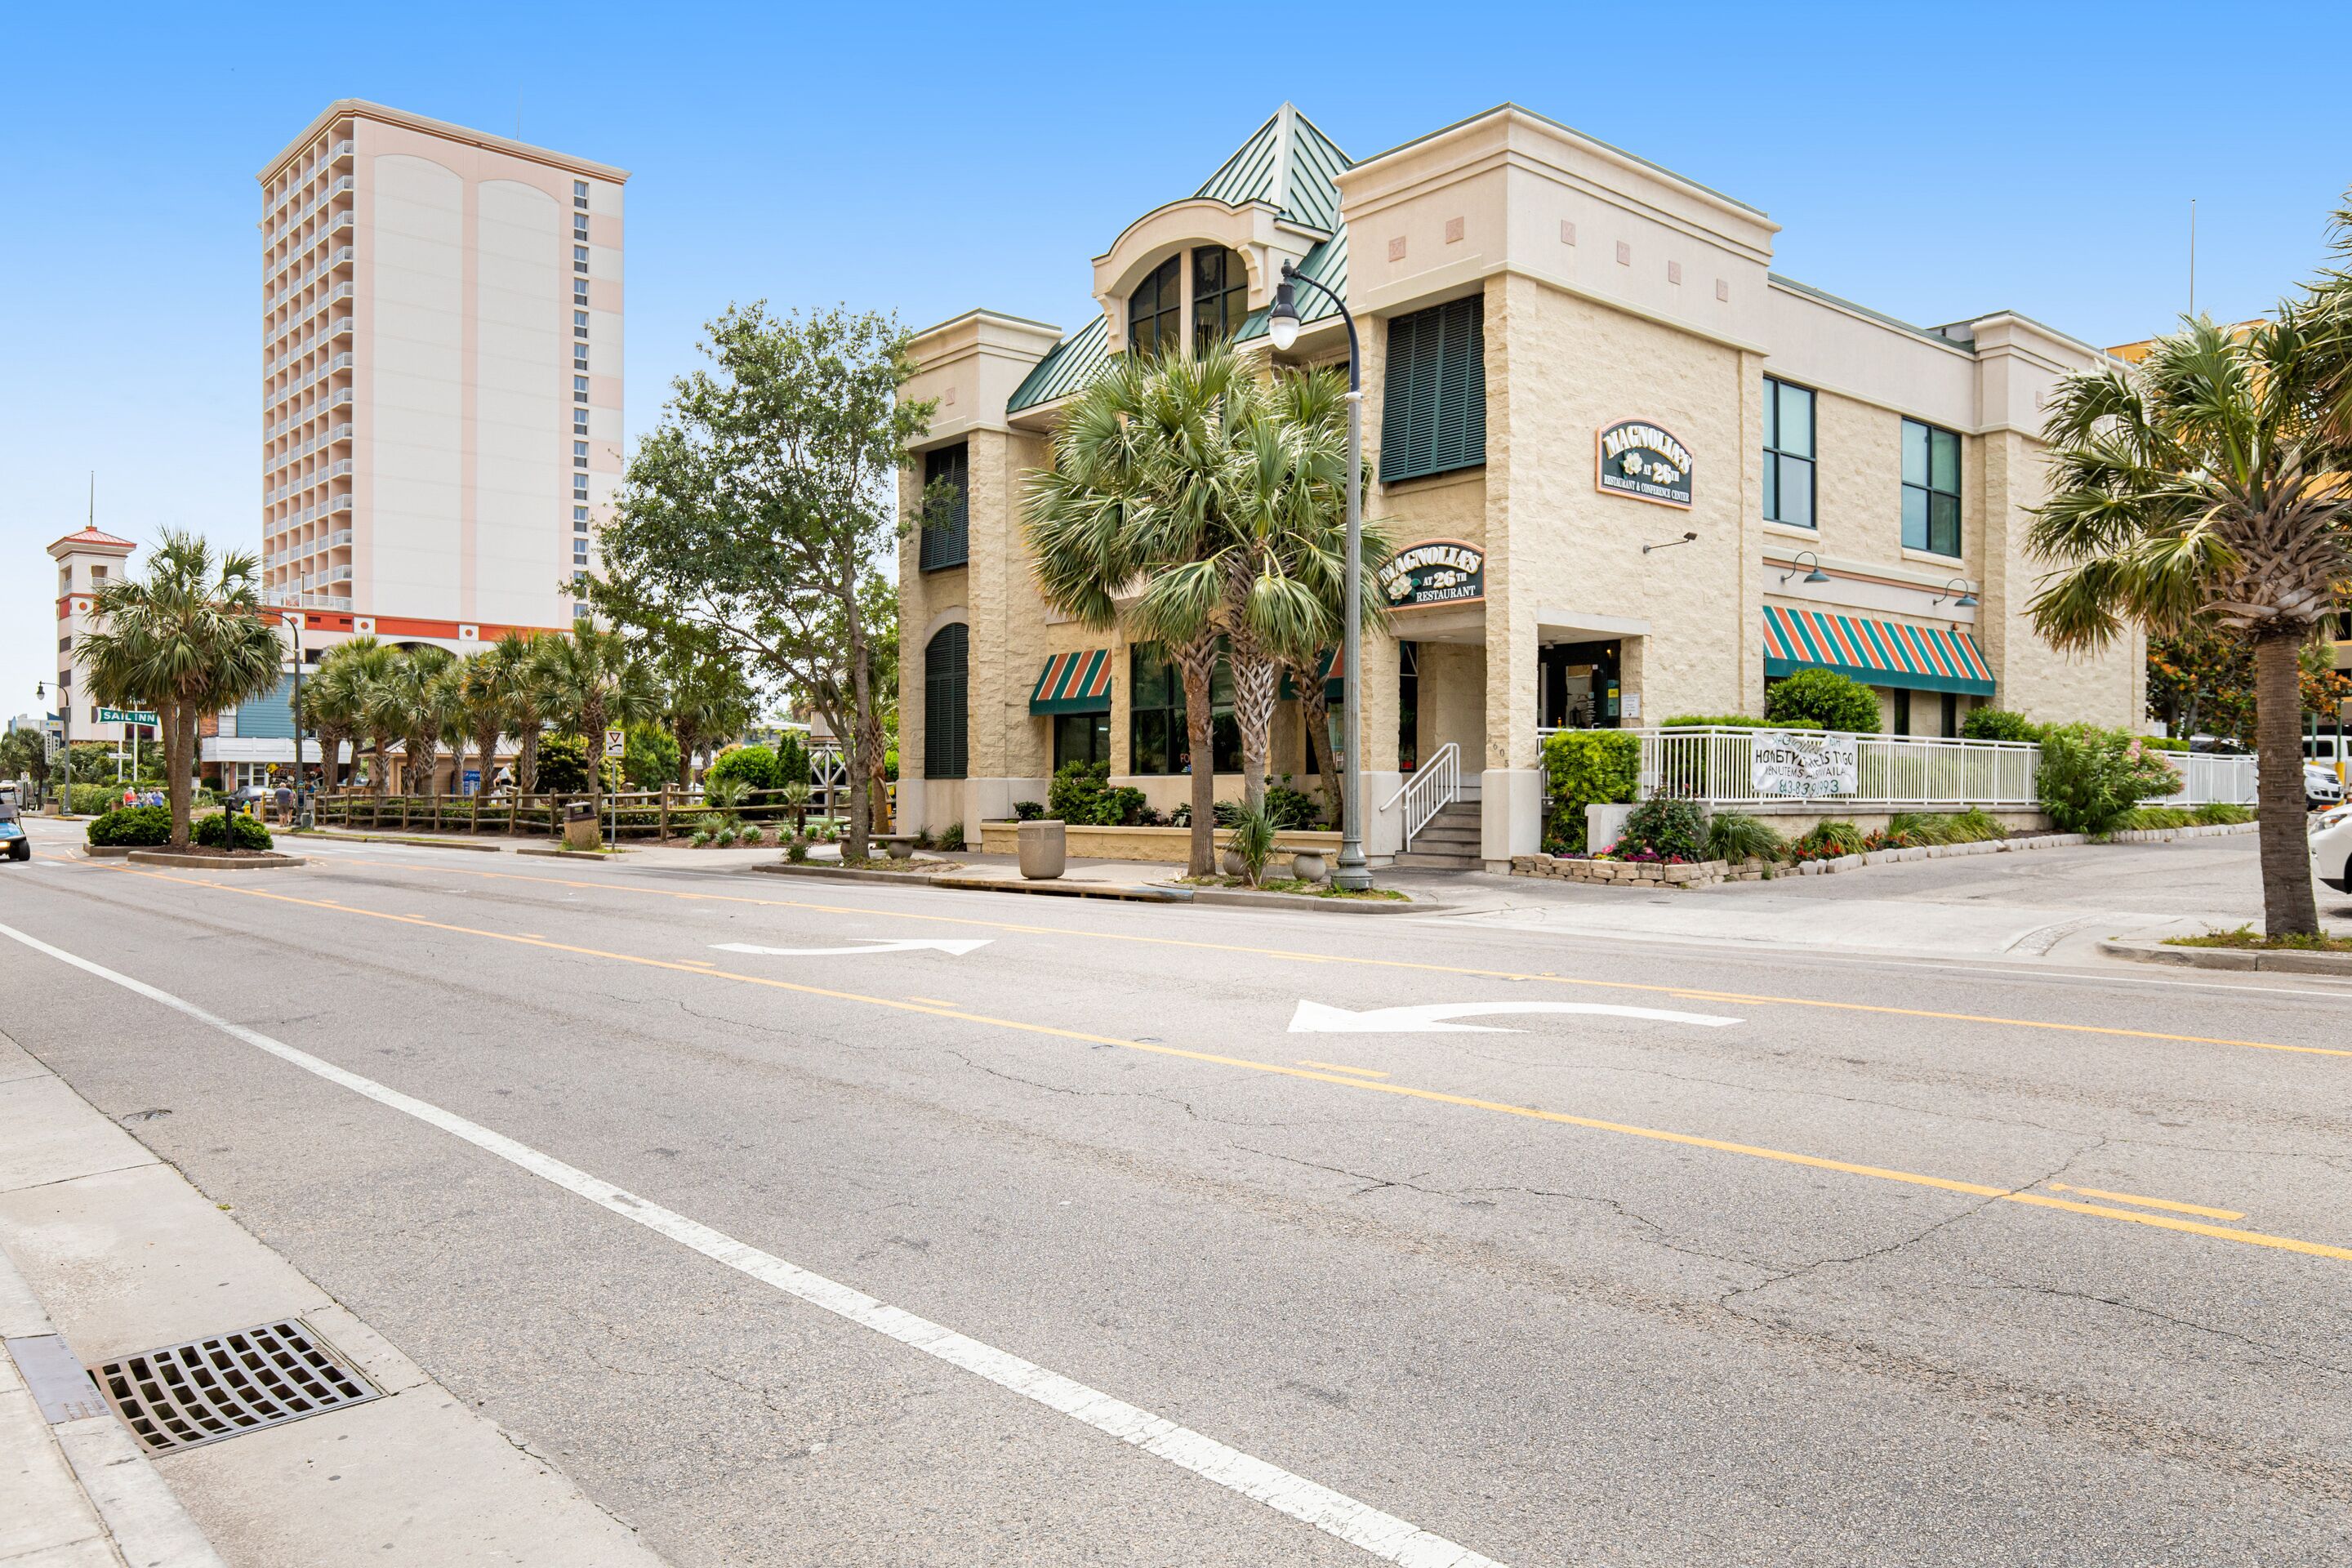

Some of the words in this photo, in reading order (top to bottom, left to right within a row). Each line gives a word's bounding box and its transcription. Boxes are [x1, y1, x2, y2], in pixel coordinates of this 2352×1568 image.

[1603, 425, 1692, 474] MAGNOLIA'S
[1643, 464, 1651, 475] AT
[1653, 462, 1679, 484] 26TH
[1604, 474, 1635, 490] RESTAURANT
[1636, 482, 1641, 491] &
[1642, 483, 1671, 498] CONFERENCE
[1671, 490, 1690, 502] CENTER
[1379, 546, 1481, 586] MAGNOLIA'S
[1423, 577, 1433, 586] AT
[1433, 570, 1468, 589] 26TH
[1416, 586, 1476, 602] RESTAURANT
[104, 711, 131, 720] SAIL
[135, 714, 154, 722] INN
